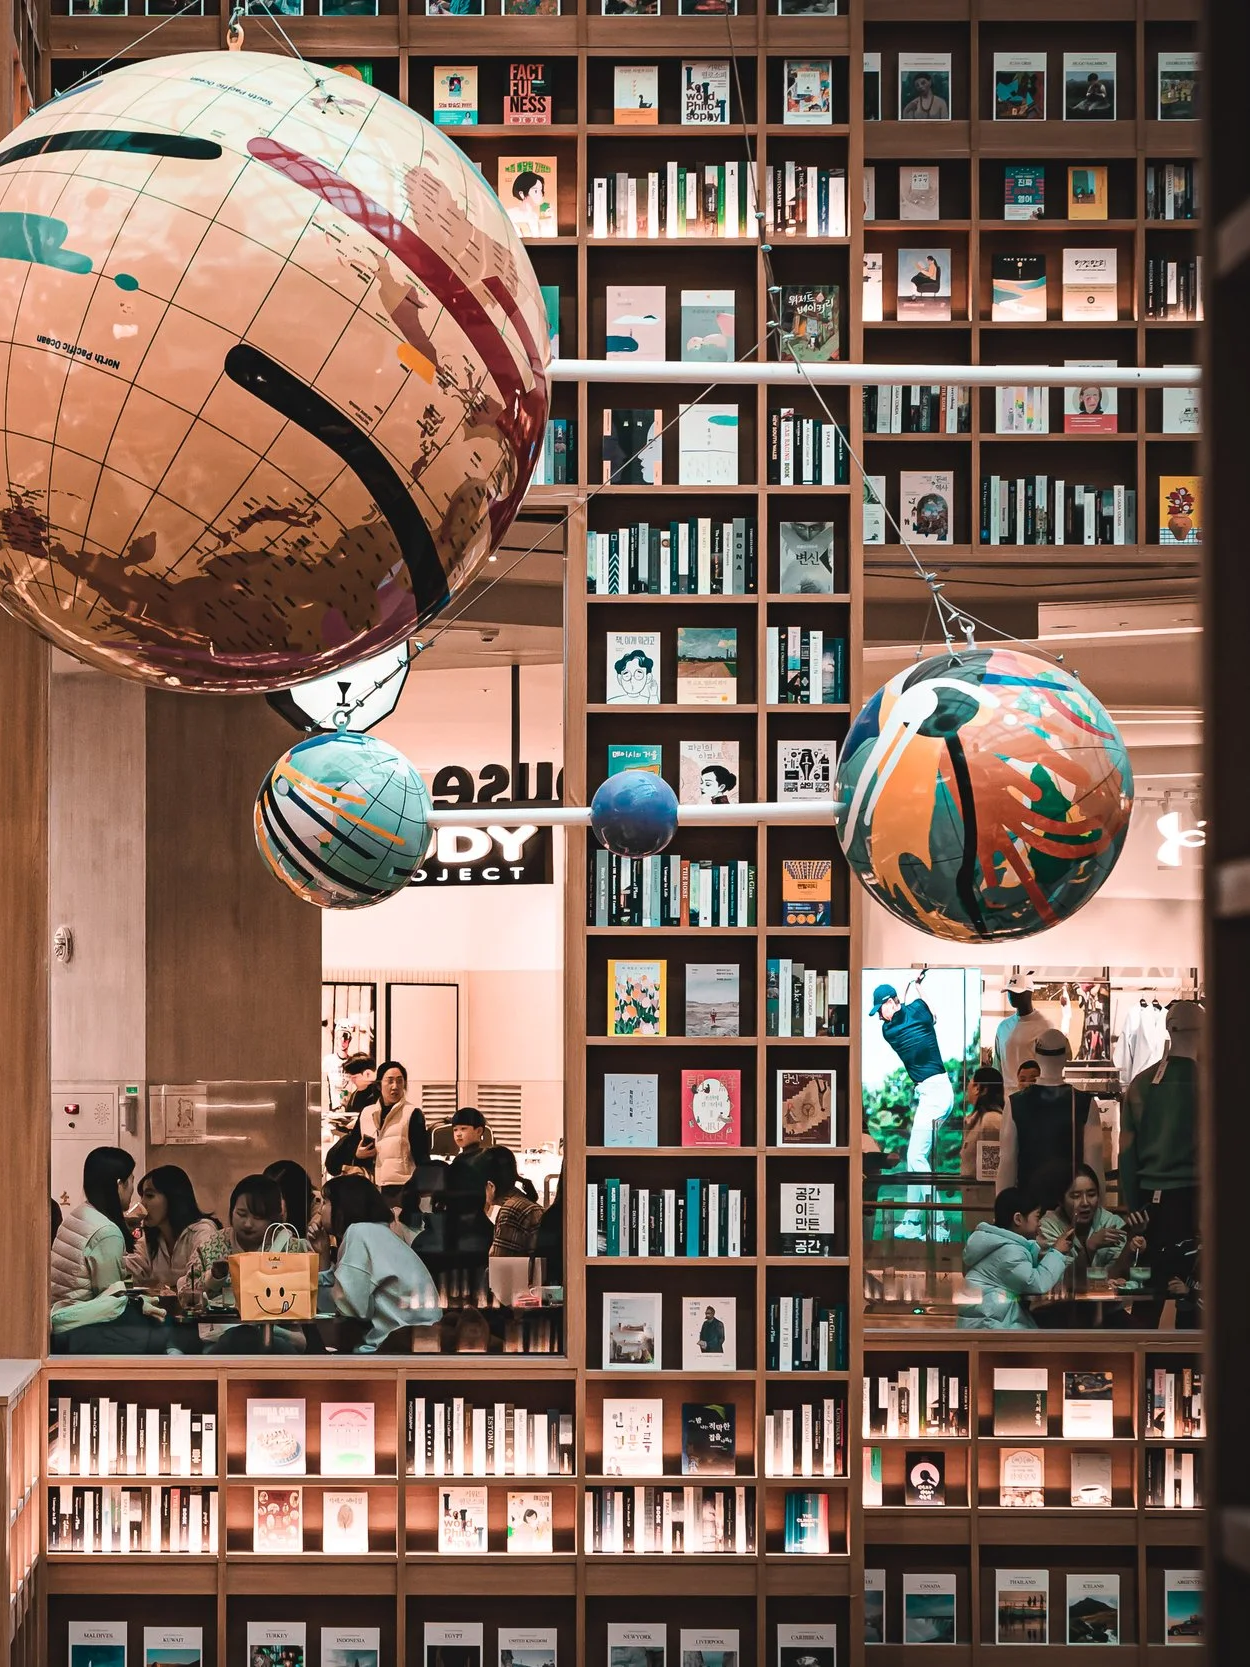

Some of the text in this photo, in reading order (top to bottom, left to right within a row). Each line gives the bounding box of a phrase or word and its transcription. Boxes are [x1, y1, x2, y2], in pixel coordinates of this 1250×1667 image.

[509, 63, 544, 80] FACT
[217, 82, 247, 96] Pacific
[509, 80, 535, 96] FUL
[248, 93, 274, 107] South
[509, 96, 546, 113] NESS
[686, 111, 720, 123] sophy
[788, 291, 815, 305] 위저드
[796, 298, 834, 314] 베이커리
[36, 334, 121, 370] North Pacific Ocean
[921, 395, 930, 432] San Francisco
[795, 552, 820, 566] 변신
[614, 635, 633, 645] 책, 이게
[687, 743, 713, 752] 파리의
[610, 750, 656, 760] 메이시의 거울
[748, 869, 756, 899] Art Glass
[633, 886, 641, 898] Plan
[793, 983, 803, 1002] Lake
[795, 1187, 820, 1201] 공간
[795, 1203, 806, 1216] 이
[795, 1218, 820, 1231] 만든
[794, 1239, 821, 1254] 공간
[829, 1312, 837, 1342] Art Glass
[83, 1631, 114, 1639] MALDIVES
